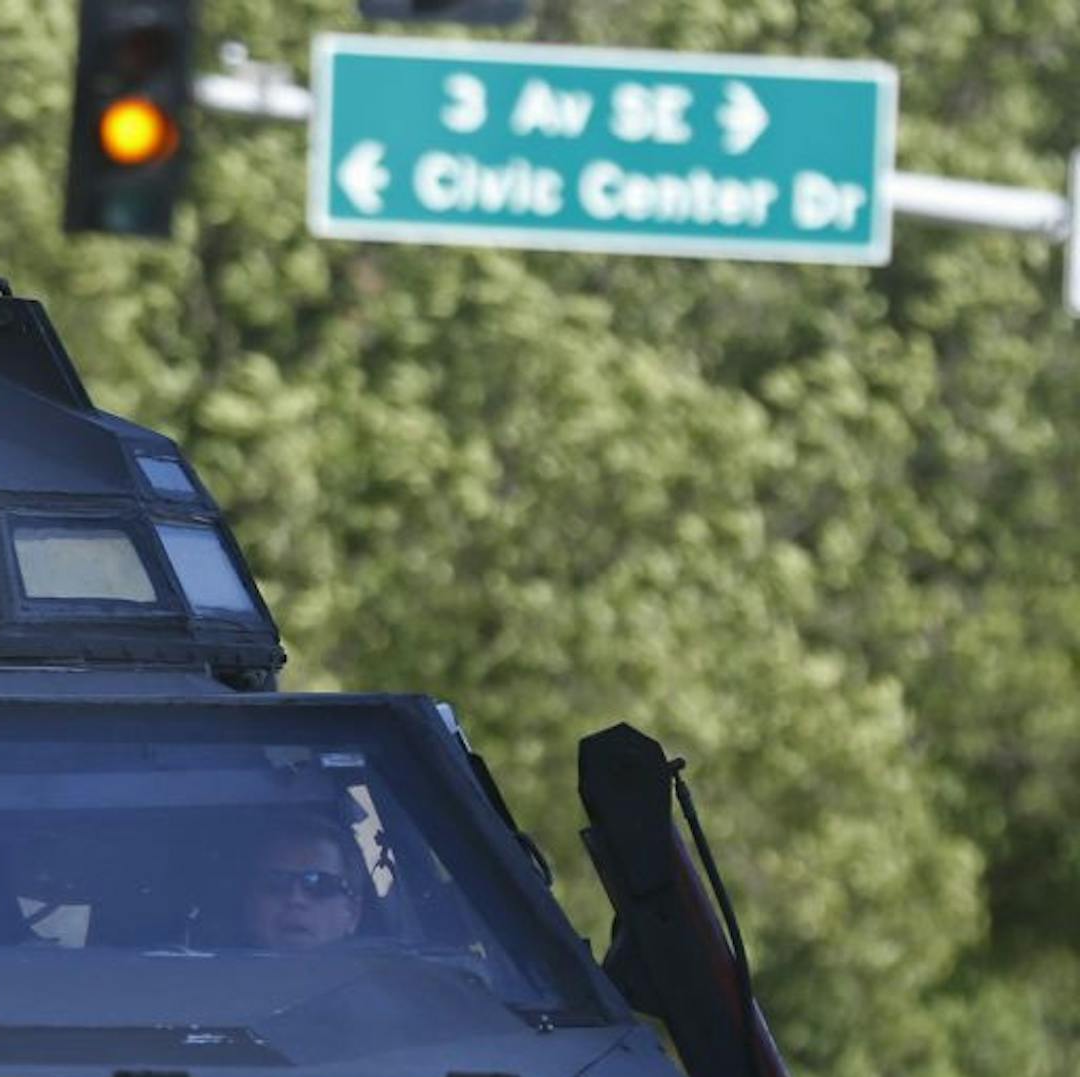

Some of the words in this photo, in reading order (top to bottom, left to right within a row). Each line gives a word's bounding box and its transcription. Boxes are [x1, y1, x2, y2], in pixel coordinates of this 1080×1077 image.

[440, 72, 488, 134] 3
[509, 78, 594, 138] Av
[609, 82, 694, 144] SE
[412, 150, 564, 217] Civic
[577, 158, 778, 227] Center
[790, 169, 866, 231] Dr
